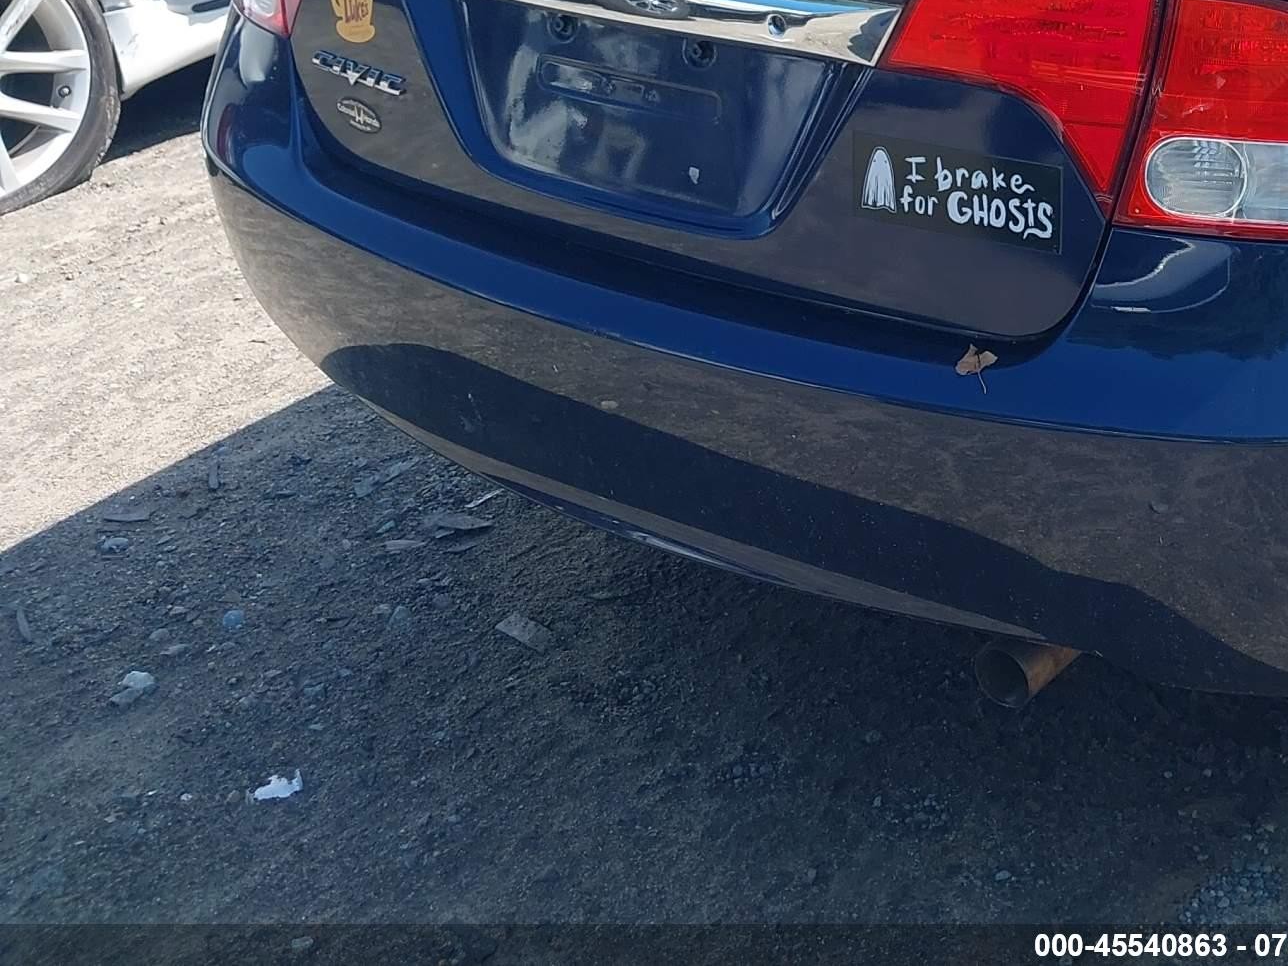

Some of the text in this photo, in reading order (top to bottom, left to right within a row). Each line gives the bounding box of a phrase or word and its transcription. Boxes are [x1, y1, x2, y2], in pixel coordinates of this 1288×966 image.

[311, 50, 406, 96] CIVIC
[903, 155, 1035, 194] I brake
[899, 184, 939, 217] for
